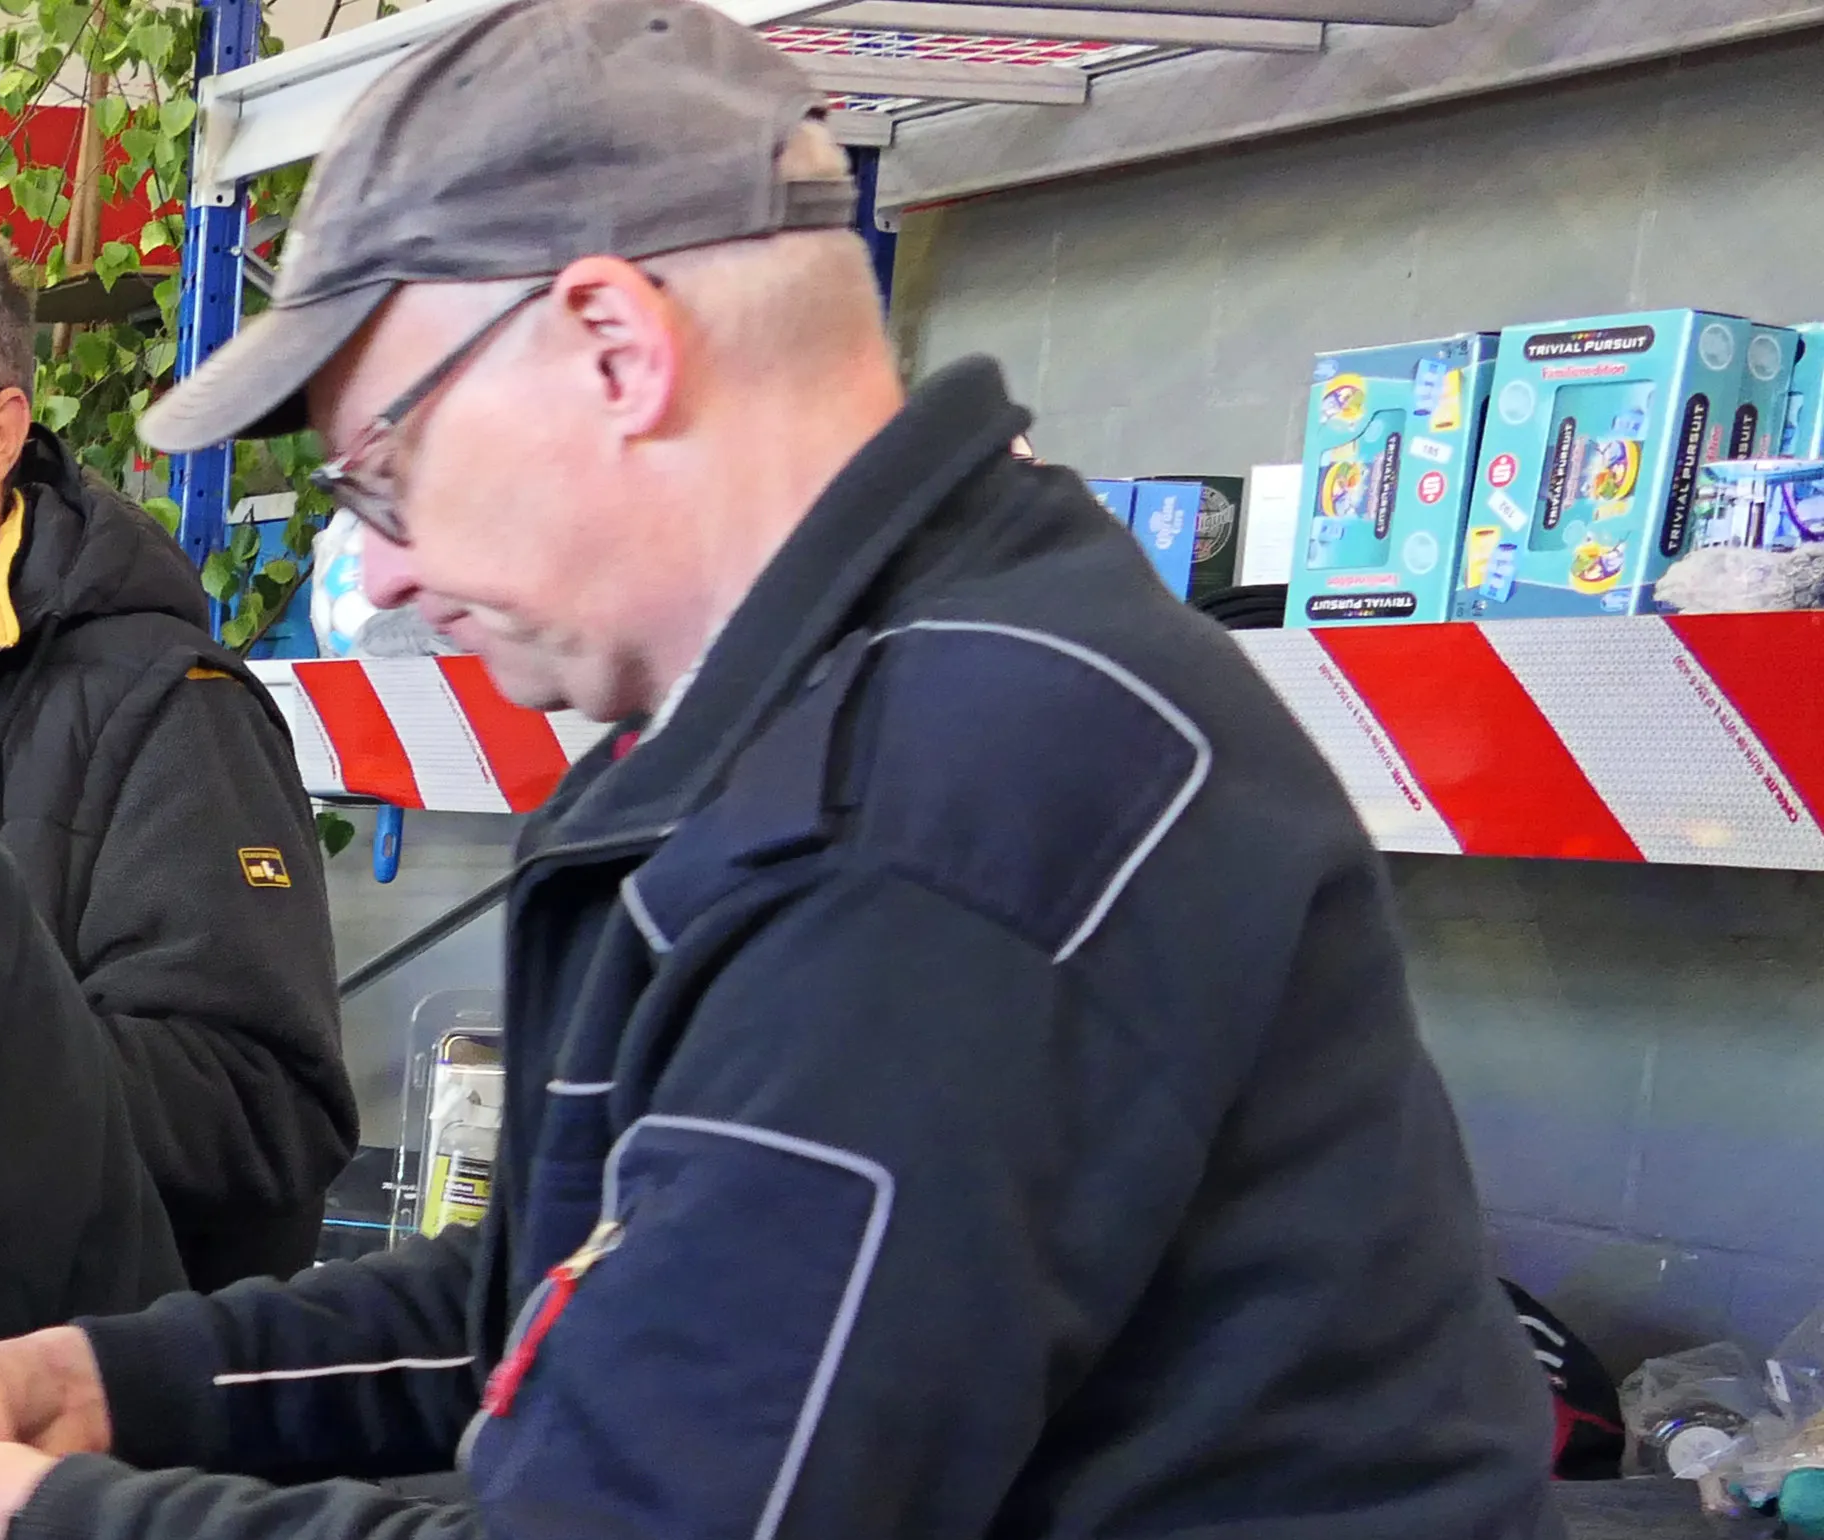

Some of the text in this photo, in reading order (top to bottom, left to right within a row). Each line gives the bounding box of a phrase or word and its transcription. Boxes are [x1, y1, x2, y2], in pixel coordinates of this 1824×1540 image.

[1528, 336, 1648, 357] TRIVIAL PURSUIT
[1668, 403, 1705, 551] TRIVIAL PURSUIT
[1311, 596, 1414, 611] TRIVIAL PURSUIT
